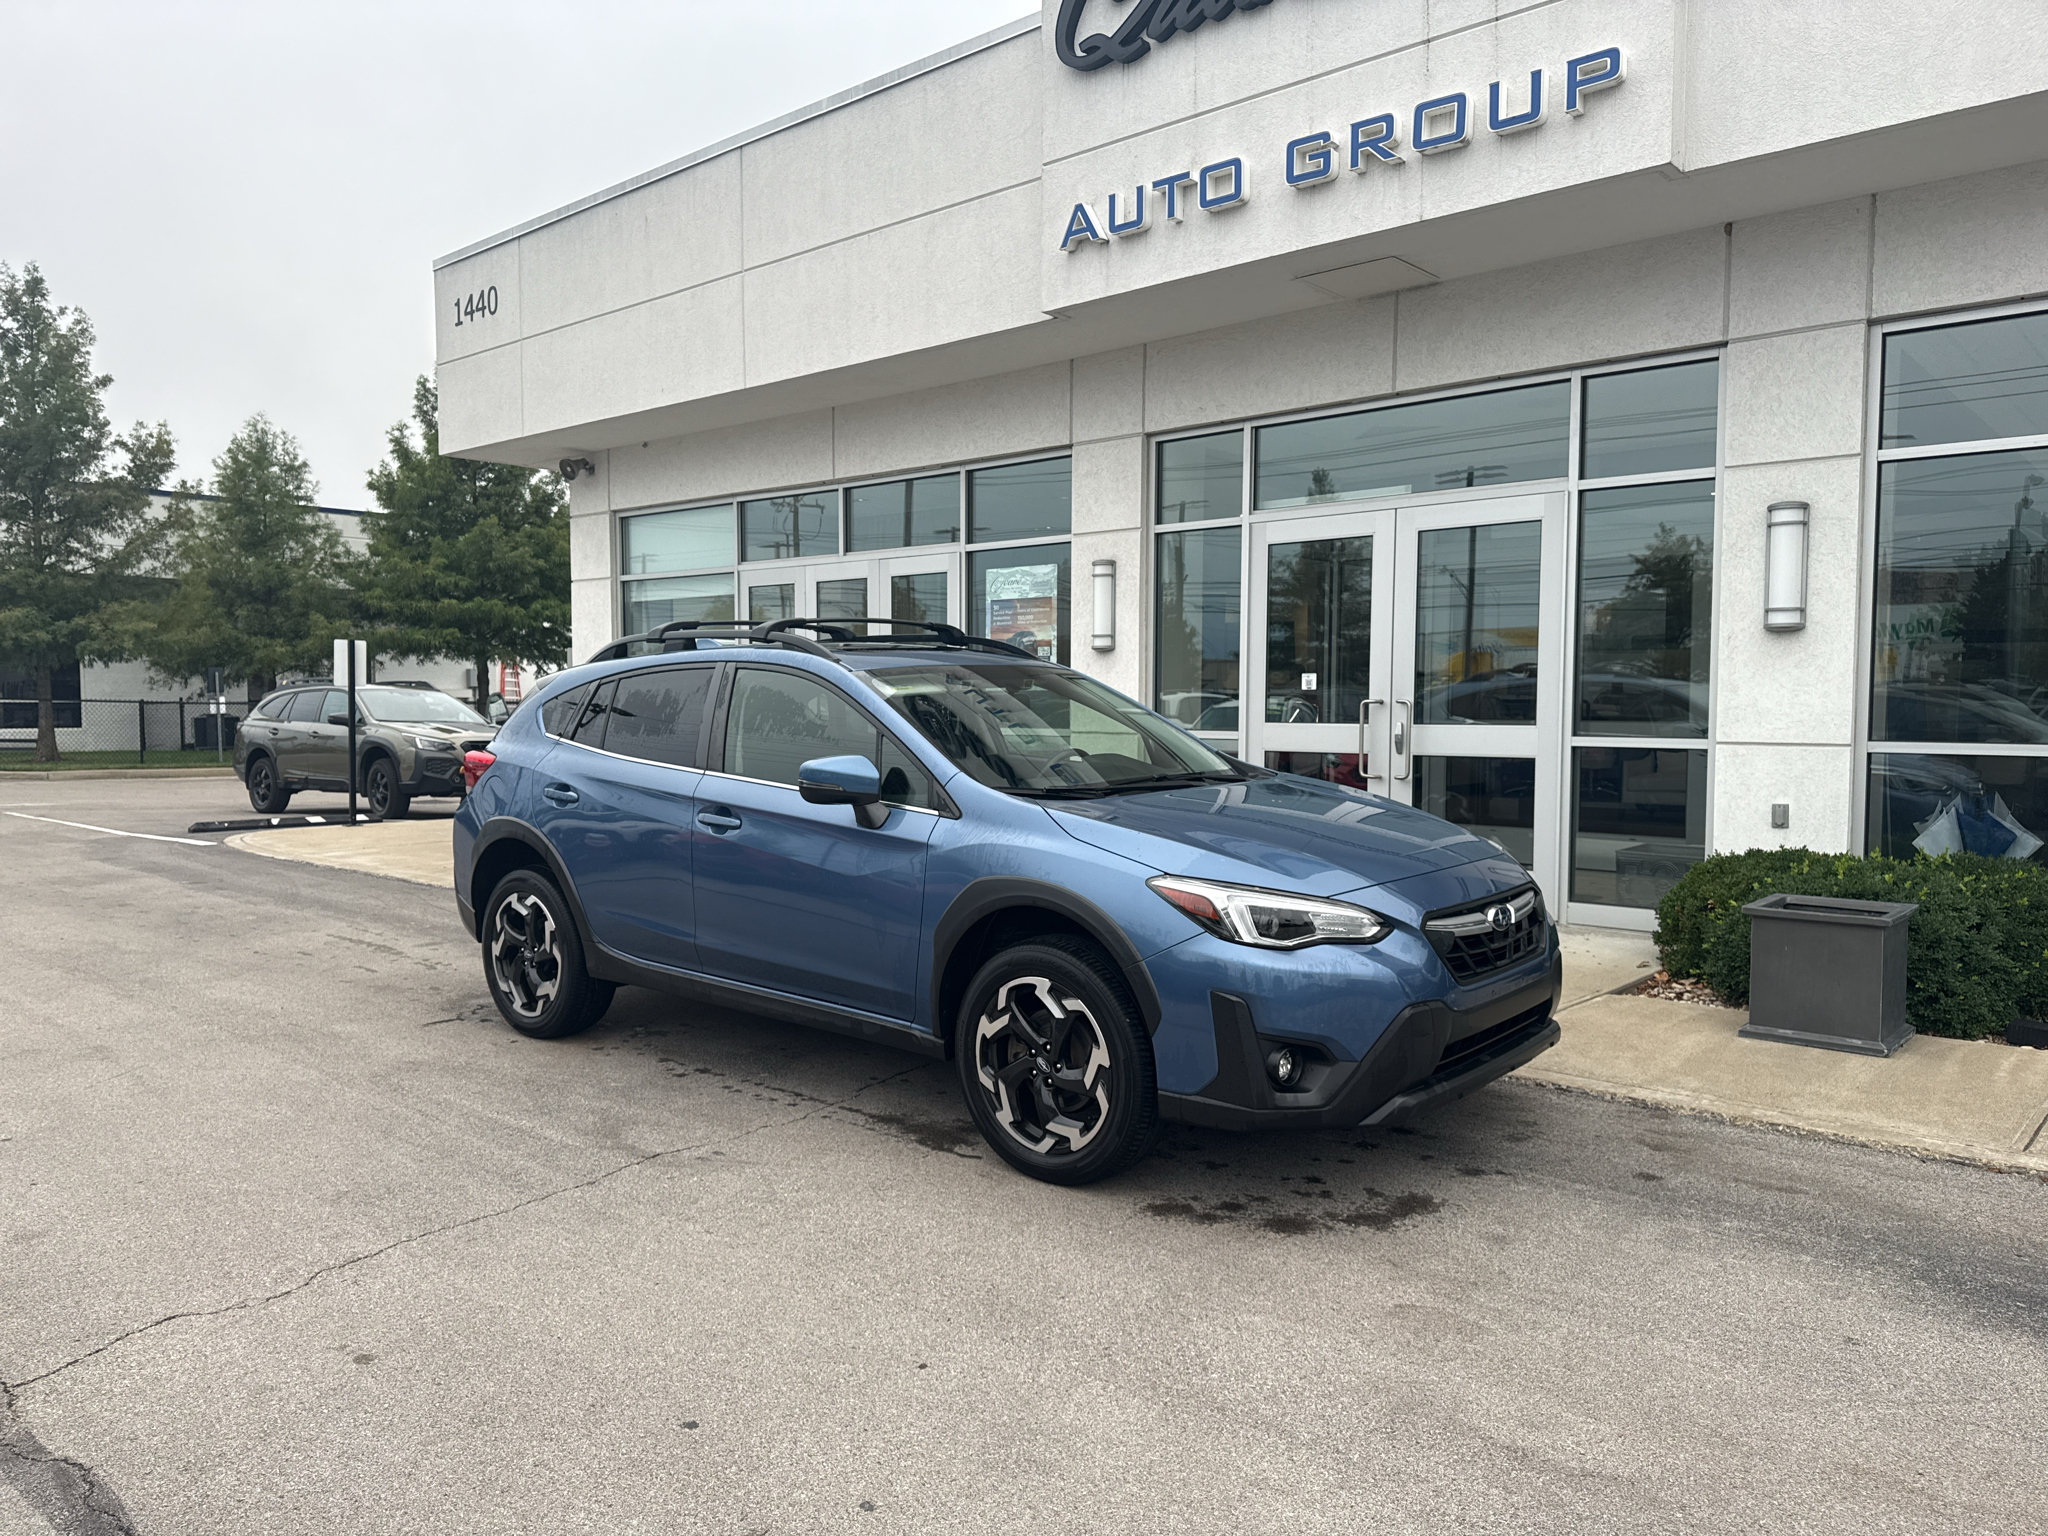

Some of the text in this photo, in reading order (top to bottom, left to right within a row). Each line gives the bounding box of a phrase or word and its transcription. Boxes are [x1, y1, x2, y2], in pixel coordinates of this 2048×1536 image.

[1059, 46, 1626, 252] AUTO GROUP
[454, 285, 498, 327] 1440
